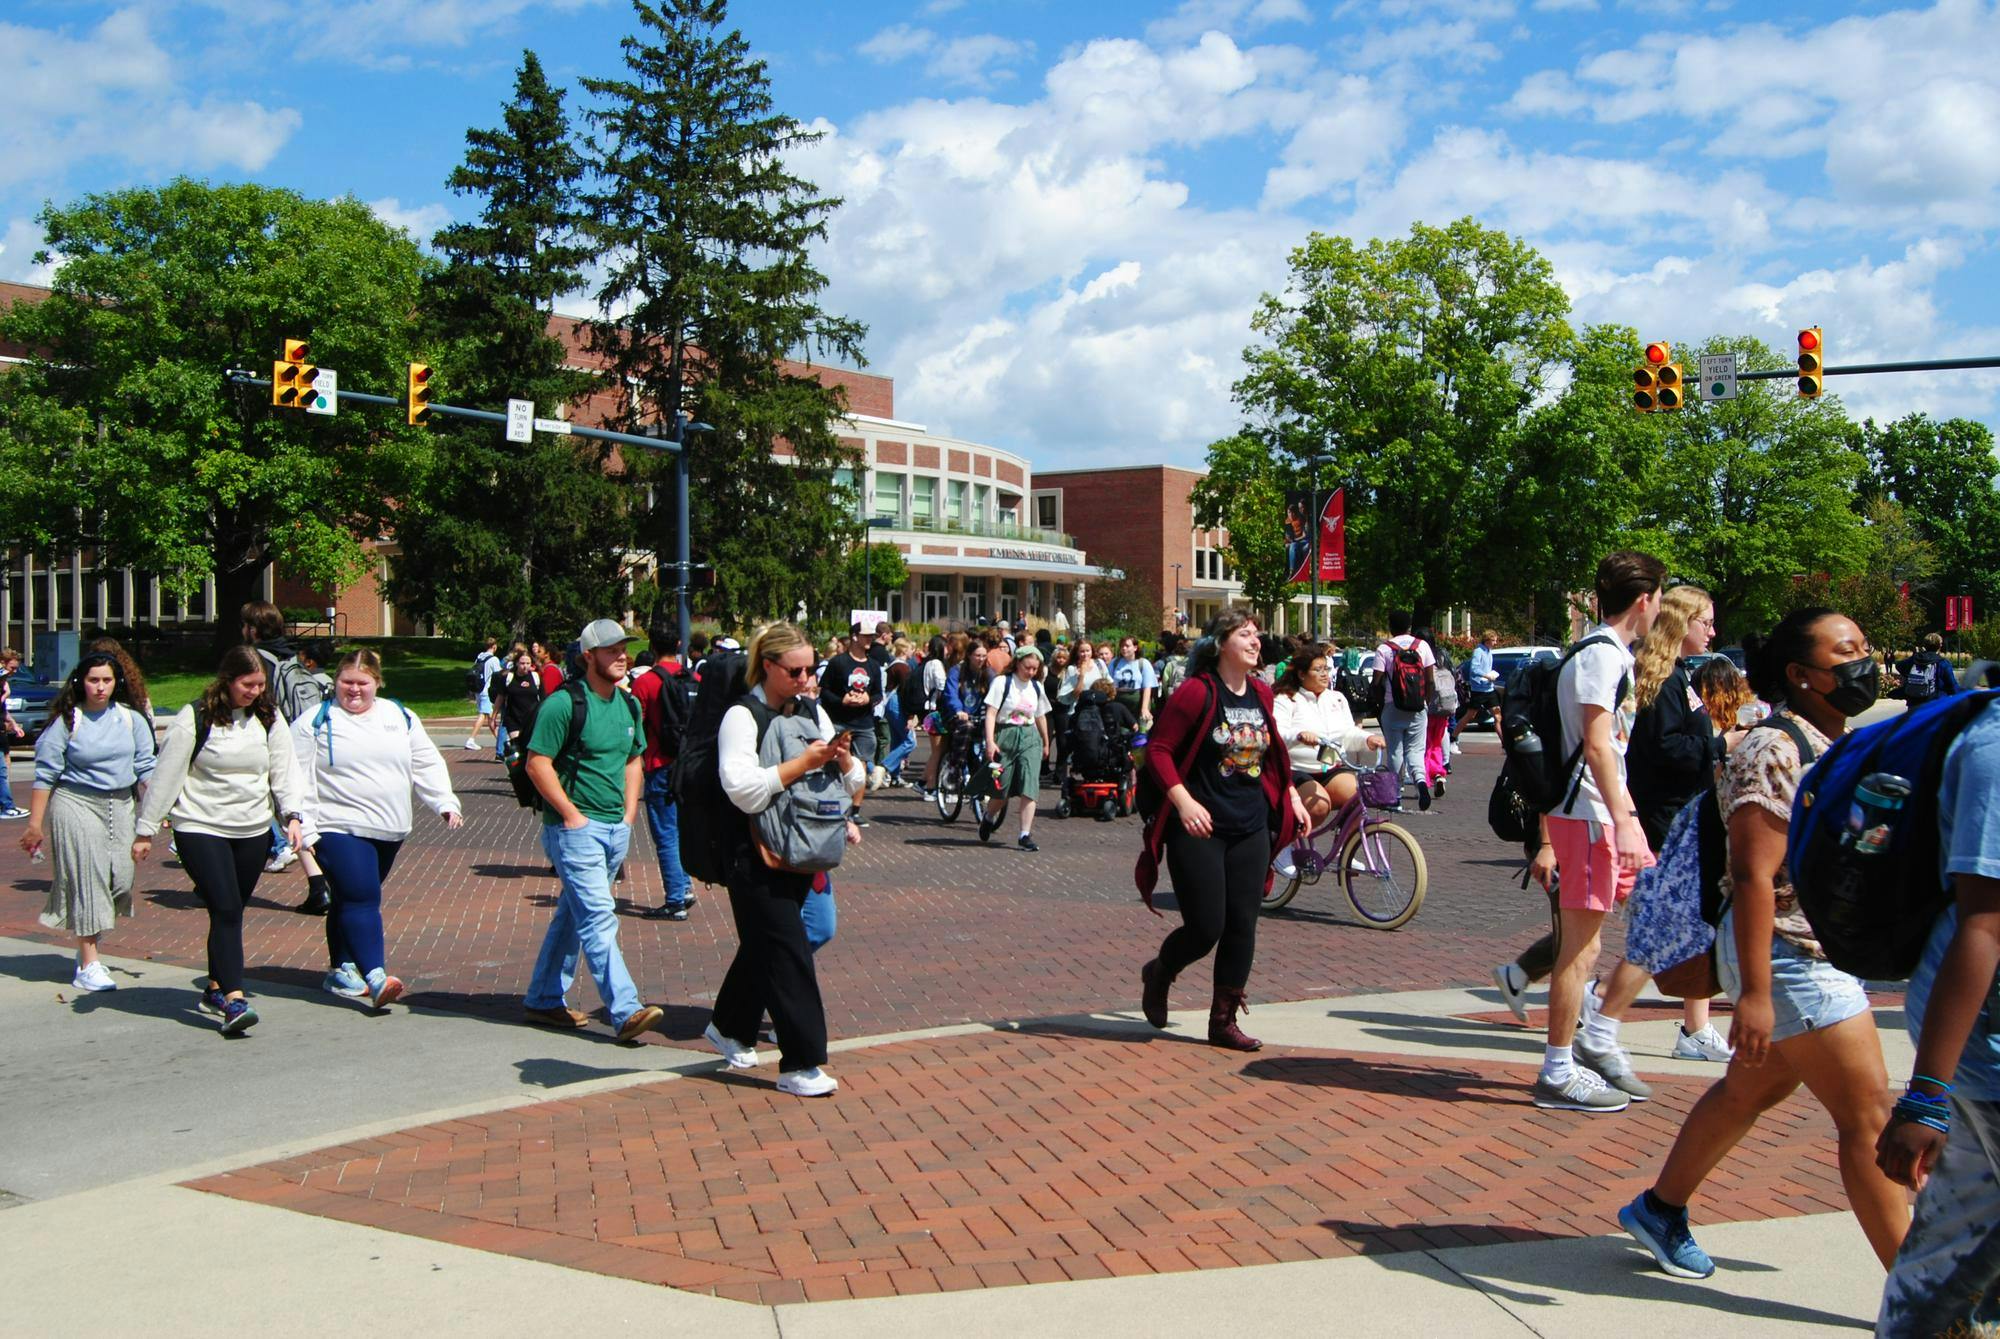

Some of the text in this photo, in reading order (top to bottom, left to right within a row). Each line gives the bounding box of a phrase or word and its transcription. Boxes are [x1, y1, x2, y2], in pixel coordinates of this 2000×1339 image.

[515, 404, 526, 412] NO
[514, 413, 528, 421] TURN
[514, 430, 524, 438] RED
[989, 547, 1077, 564] EMENS AUDITORIUM
